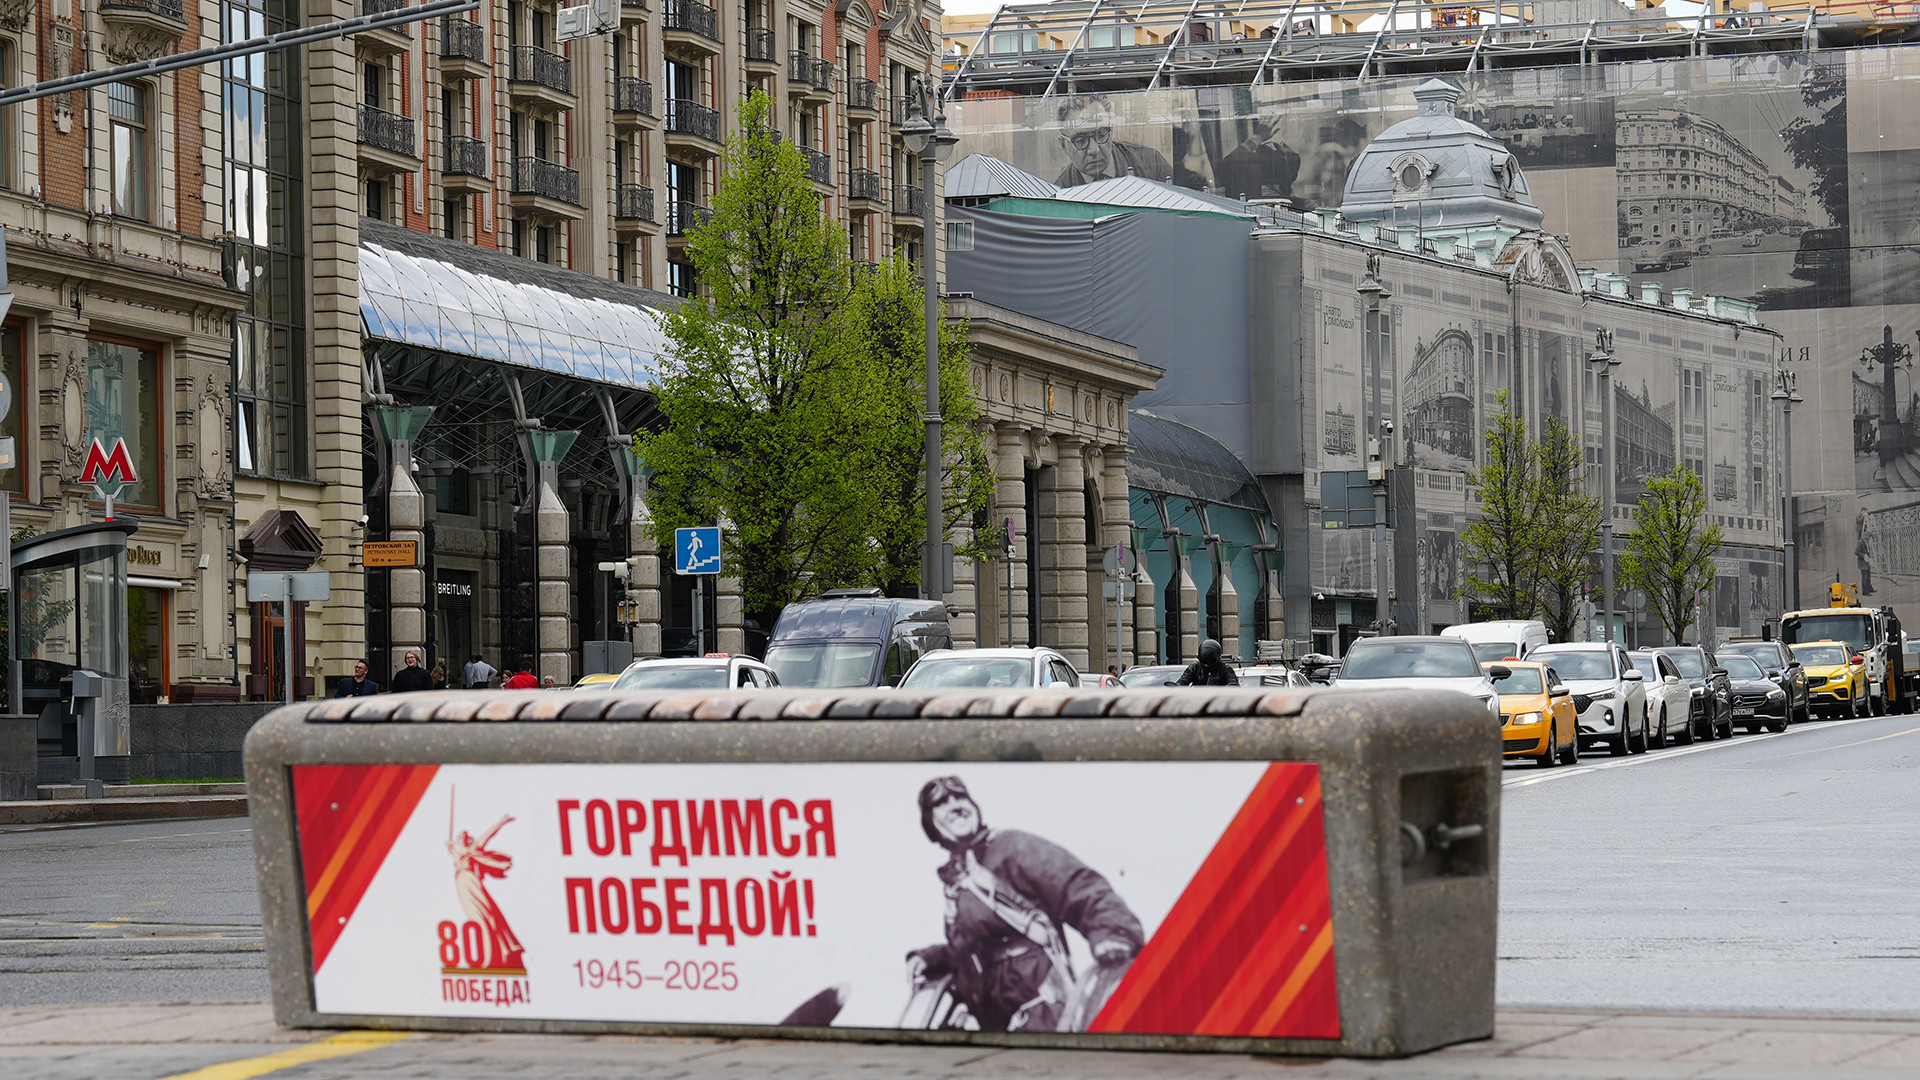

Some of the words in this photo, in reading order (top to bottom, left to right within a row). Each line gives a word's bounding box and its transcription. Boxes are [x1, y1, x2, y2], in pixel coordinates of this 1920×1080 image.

[437, 583, 472, 596] BREITLING
[557, 798, 836, 867] ГОРДИМСЯ
[564, 870, 817, 946] ПОБЕДОЙ!
[438, 920, 485, 968] 80
[441, 976, 531, 1007] ПОБЕДА!
